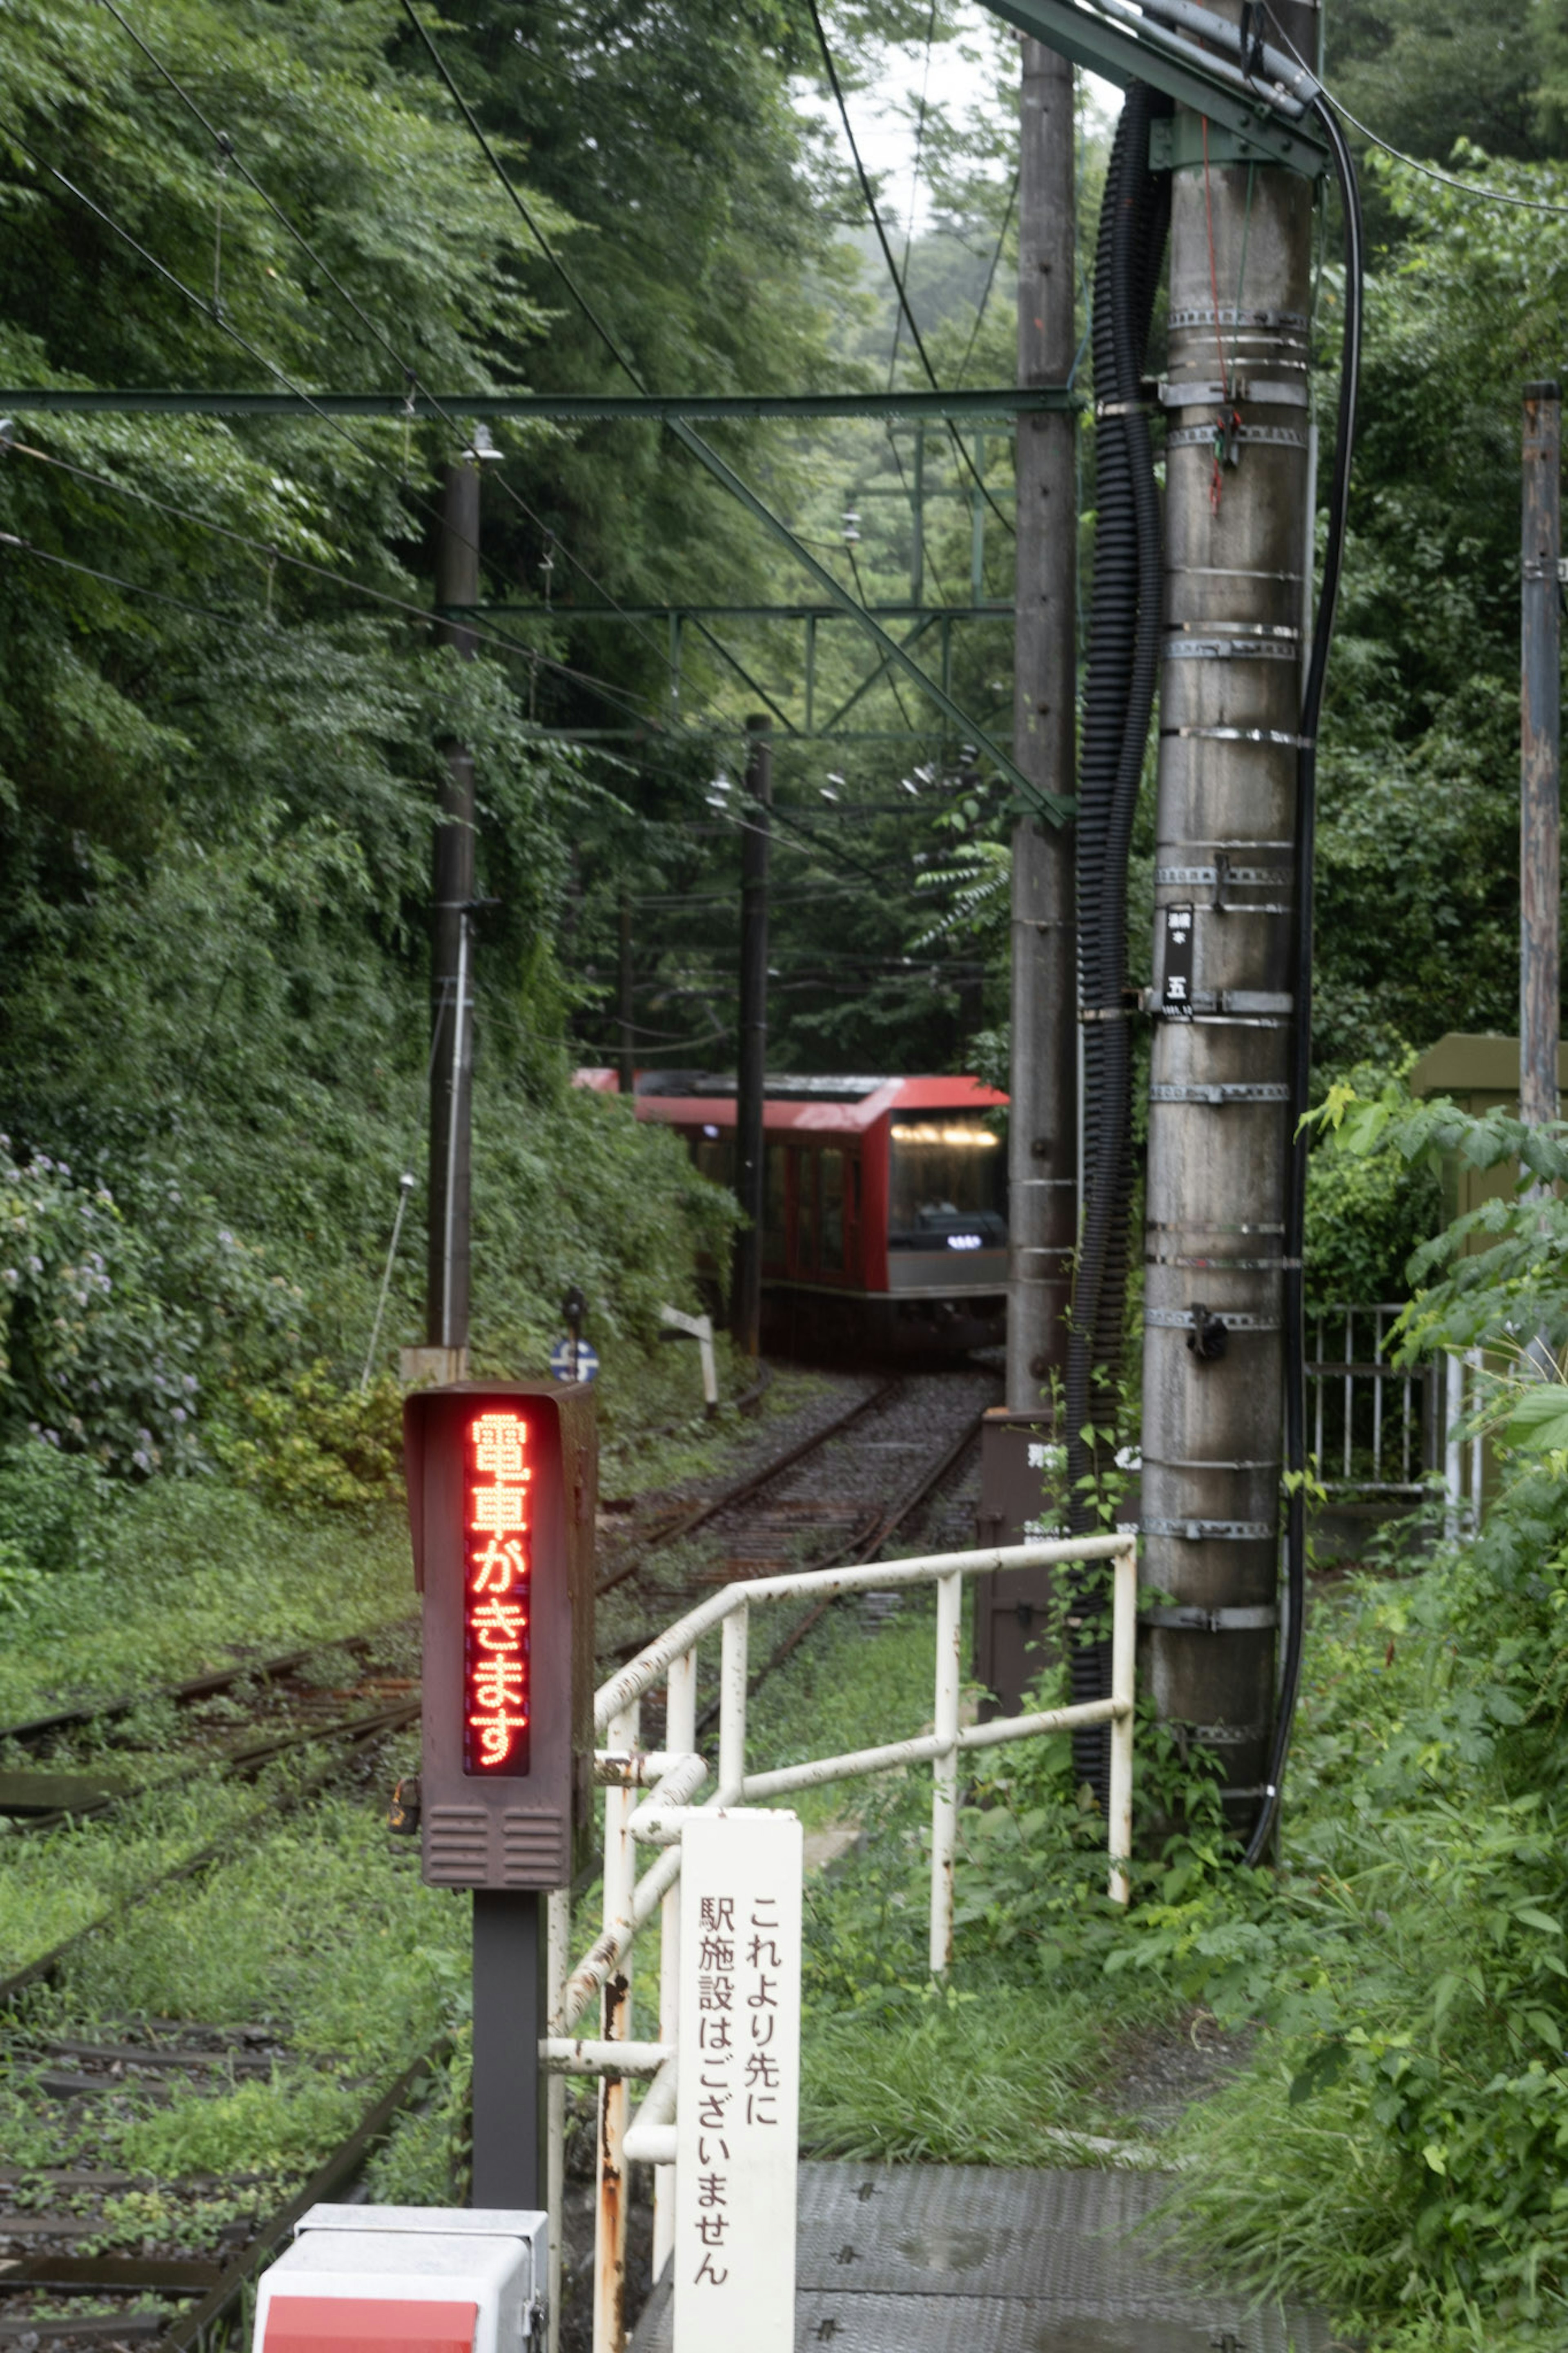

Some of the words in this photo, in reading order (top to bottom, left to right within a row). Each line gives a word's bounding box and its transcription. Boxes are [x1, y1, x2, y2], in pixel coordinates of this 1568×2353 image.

[469, 1412, 533, 1766] 電車がきます
[693, 1896, 736, 2286] 駅施設はございません
[744, 1897, 783, 2126] これより先に
